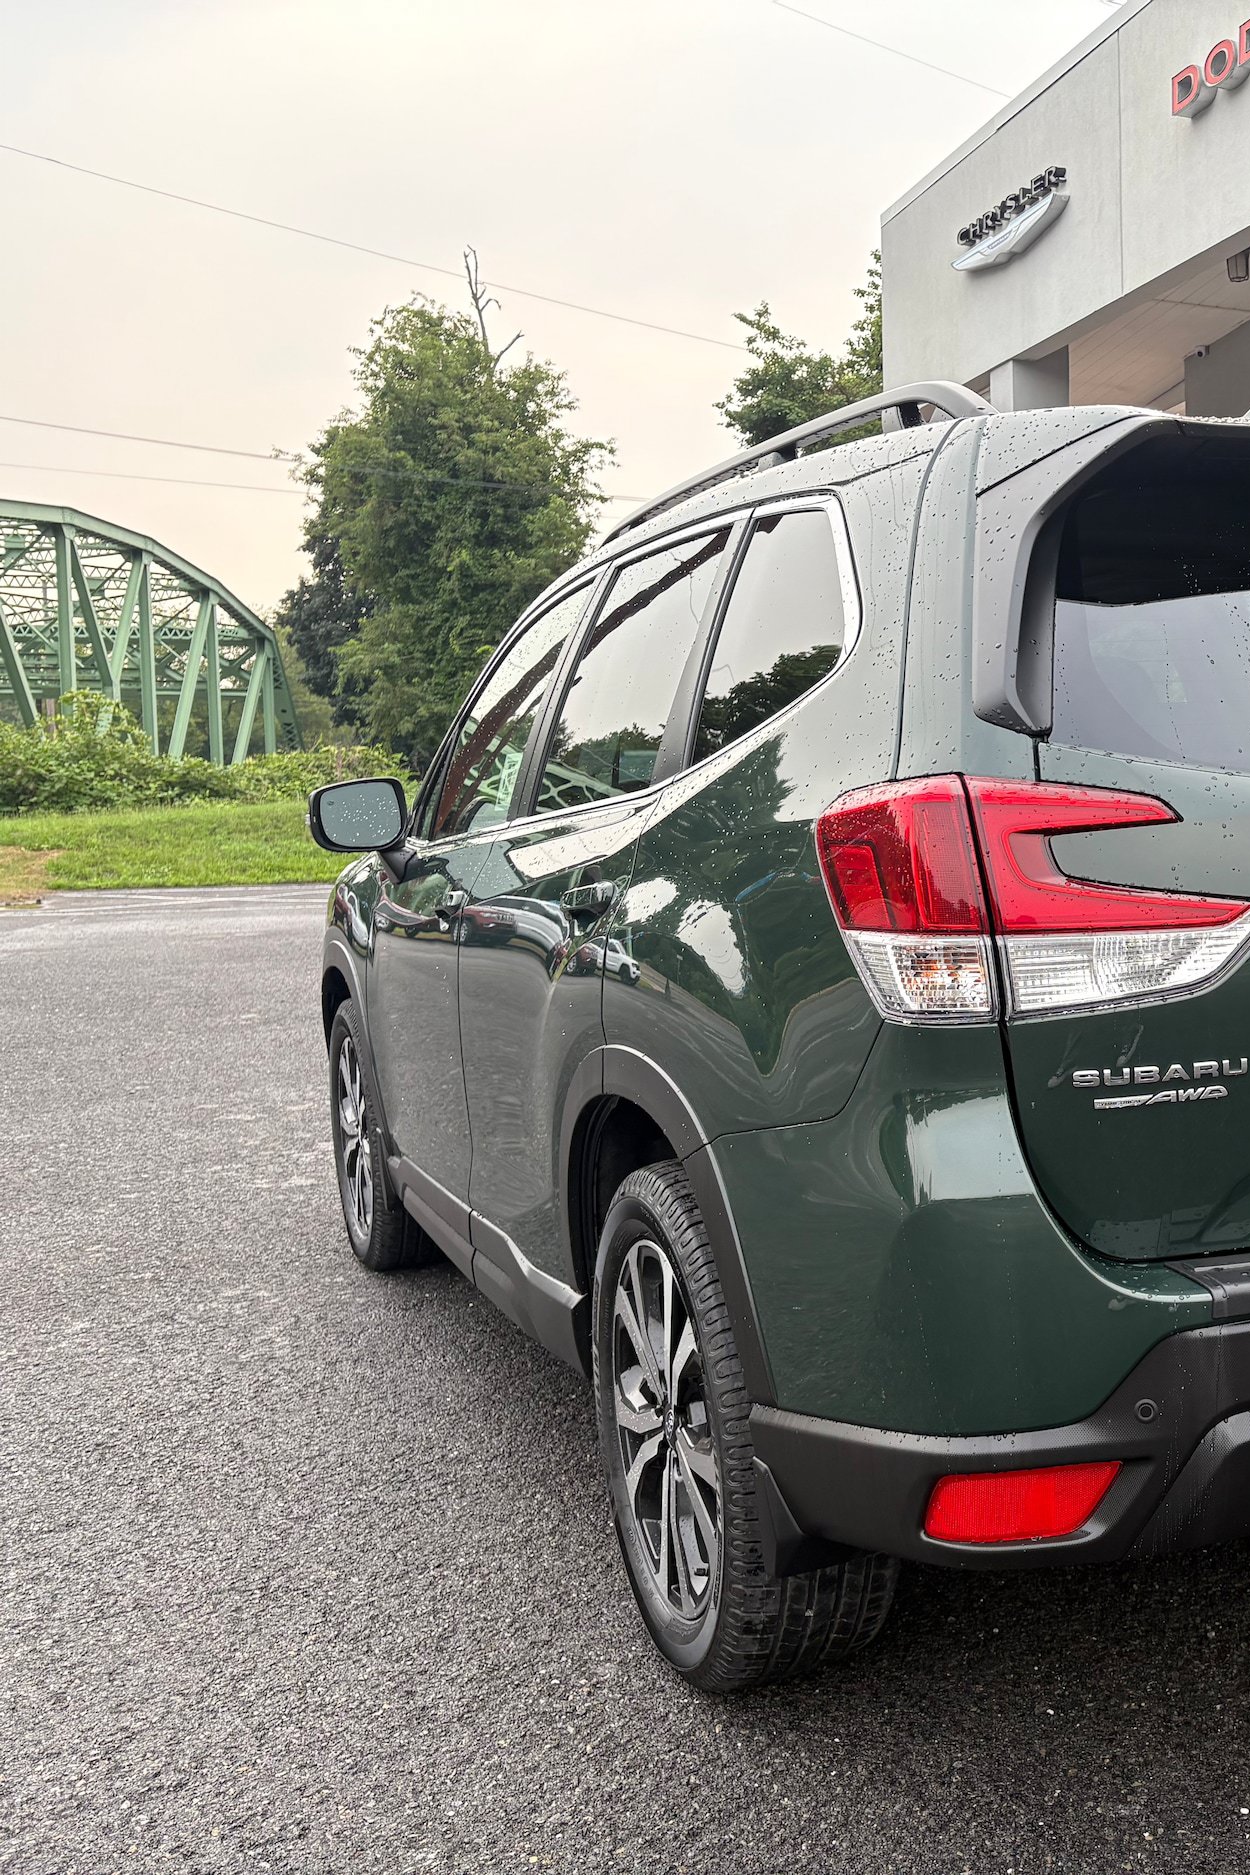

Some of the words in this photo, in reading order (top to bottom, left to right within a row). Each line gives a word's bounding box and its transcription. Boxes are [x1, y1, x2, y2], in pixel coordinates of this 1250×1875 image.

[957, 166, 1066, 246] CHRYSLER
[1072, 1057, 1248, 1088] SUBARU
[1145, 1085, 1229, 1106] AWD
